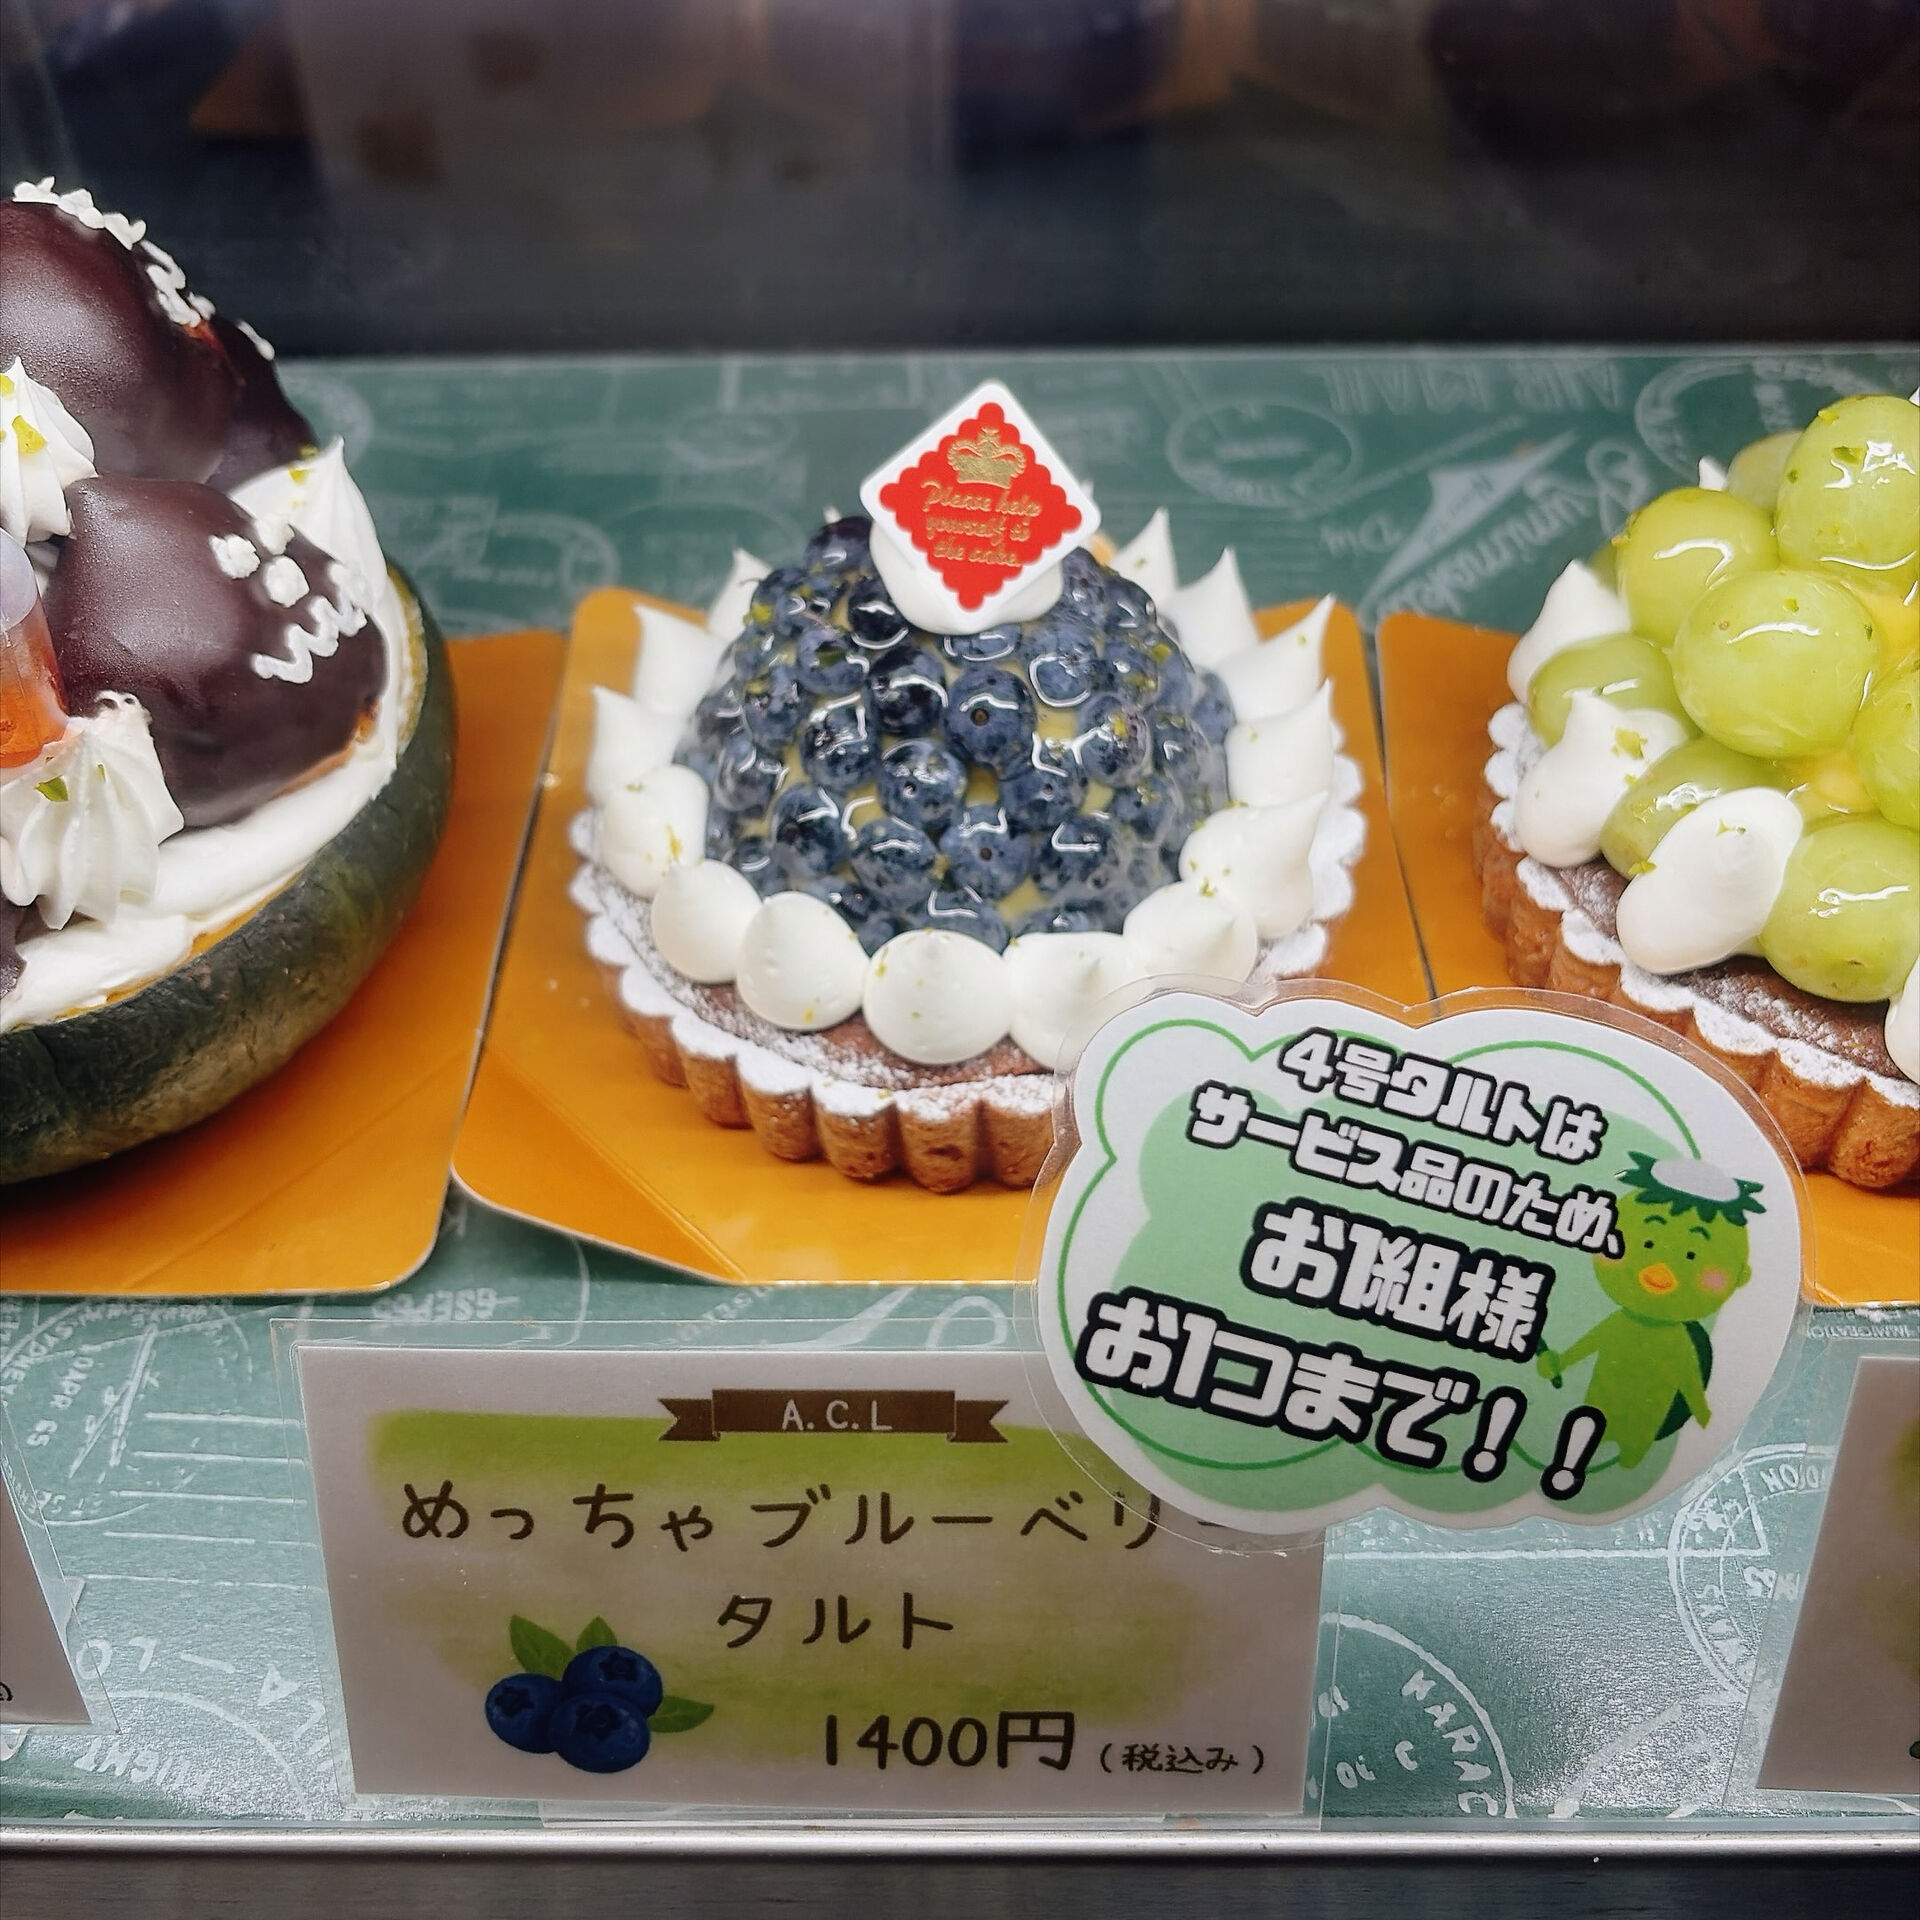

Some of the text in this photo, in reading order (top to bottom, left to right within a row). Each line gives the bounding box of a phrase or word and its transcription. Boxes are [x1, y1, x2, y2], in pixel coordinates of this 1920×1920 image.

[1277, 1026, 1607, 1160] 4号タルトは
[1243, 1198, 1556, 1362] お1組様
[780, 1402, 893, 1432] A.C.L
[402, 1480, 1230, 1554] めっちゃブルーベリ
[716, 1592, 955, 1650] タルト
[824, 1711, 1266, 1776] 1400円 （税込み）
